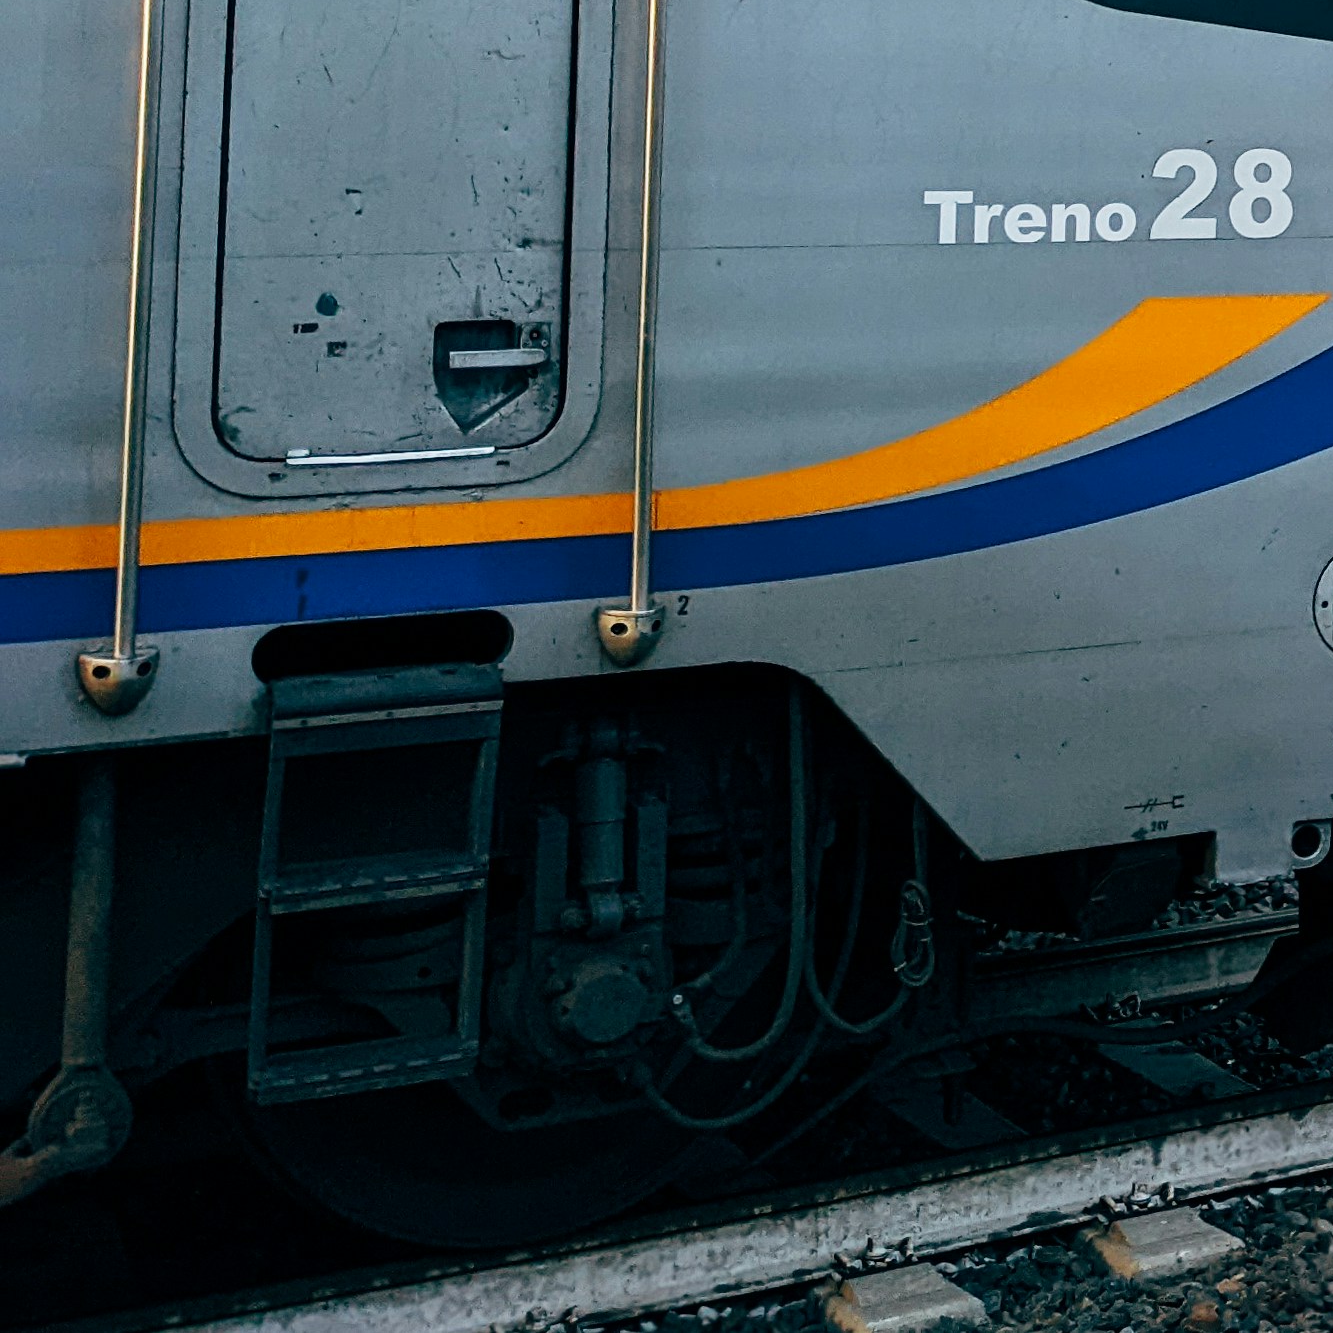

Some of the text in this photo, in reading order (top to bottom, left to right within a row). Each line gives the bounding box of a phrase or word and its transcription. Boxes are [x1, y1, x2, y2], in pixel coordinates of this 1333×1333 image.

[923, 148, 1294, 245] Treno 28
[677, 594, 689, 616] 2
